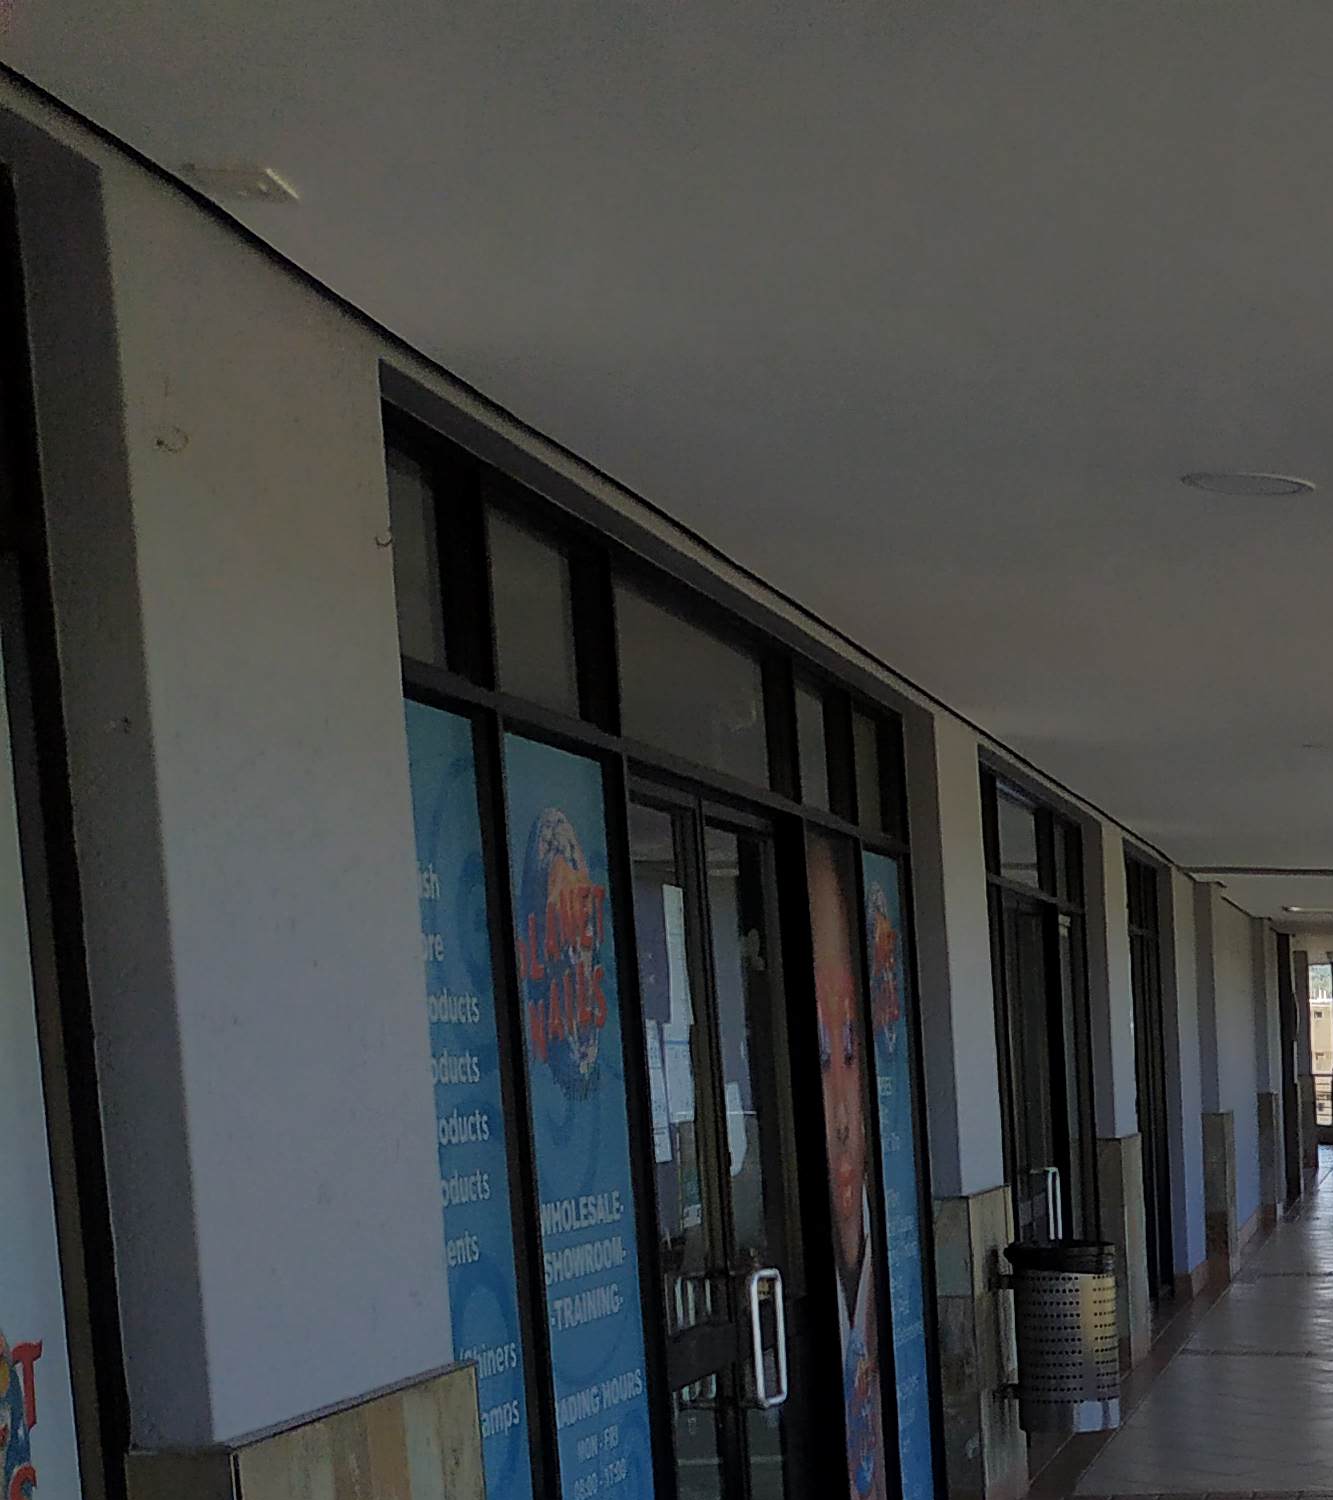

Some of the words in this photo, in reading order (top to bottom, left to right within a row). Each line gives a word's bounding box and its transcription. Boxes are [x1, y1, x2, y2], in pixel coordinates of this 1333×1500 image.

[428, 986, 481, 1025] oducts
[527, 964, 608, 1065] NAILS
[431, 1049, 481, 1085] oducts
[439, 1108, 491, 1146] oducts
[440, 1169, 491, 1207] oducts
[447, 1230, 481, 1268] ents
[558, 1384, 600, 1431] ADING
[601, 1368, 643, 1411] HOURS
[480, 1400, 520, 1438] amps
